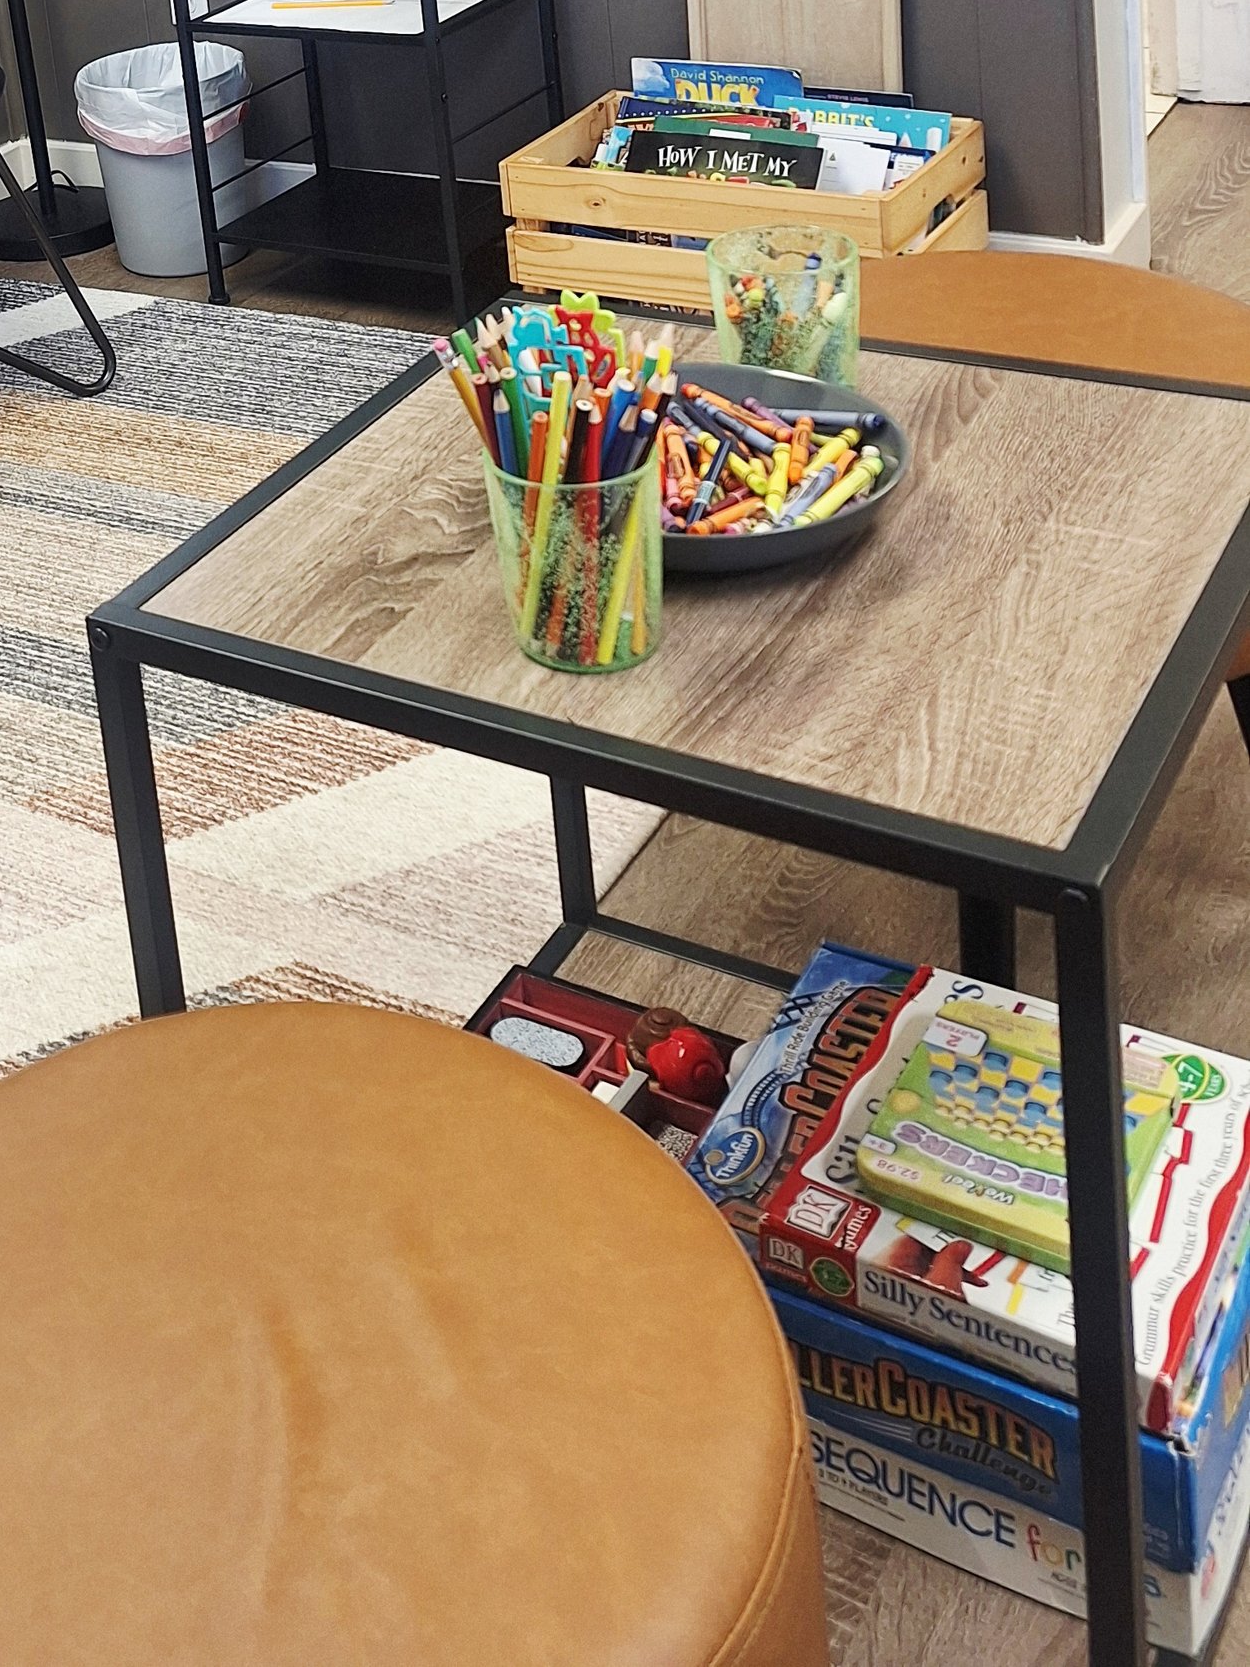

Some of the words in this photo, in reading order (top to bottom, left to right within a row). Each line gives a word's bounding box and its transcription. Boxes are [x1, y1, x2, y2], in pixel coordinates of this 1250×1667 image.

[670, 68, 706, 81] David
[710, 70, 765, 85] Shannon
[674, 78, 760, 106] DUCK
[788, 106, 875, 128] BBIT'S
[657, 144, 702, 168] HOW
[706, 149, 718, 170] I
[719, 150, 764, 174] MET
[762, 156, 797, 177] MY
[821, 980, 847, 1010] Game
[799, 999, 827, 1041] Building
[793, 1024, 806, 1048] Ride
[945, 1034, 959, 1048] 2
[778, 1040, 795, 1075] Thrill
[1230, 1094, 1242, 1110] of
[1221, 1107, 1239, 1141] years
[875, 1157, 921, 1182] $2.98
[893, 1121, 1069, 1200] HECKERS
[1214, 1140, 1231, 1172] three
[1203, 1163, 1221, 1192] first
[1190, 1181, 1205, 1207] the
[793, 1189, 839, 1230] DK
[1185, 1202, 1200, 1226] for
[770, 1238, 802, 1265] DK
[1172, 1227, 1199, 1279] practice
[864, 1270, 926, 1317] Silly
[1151, 1274, 1175, 1305] skills
[1136, 1305, 1160, 1367] Grammar
[810, 1430, 1016, 1549] SEQUENCE
[1026, 1523, 1081, 1570] for
